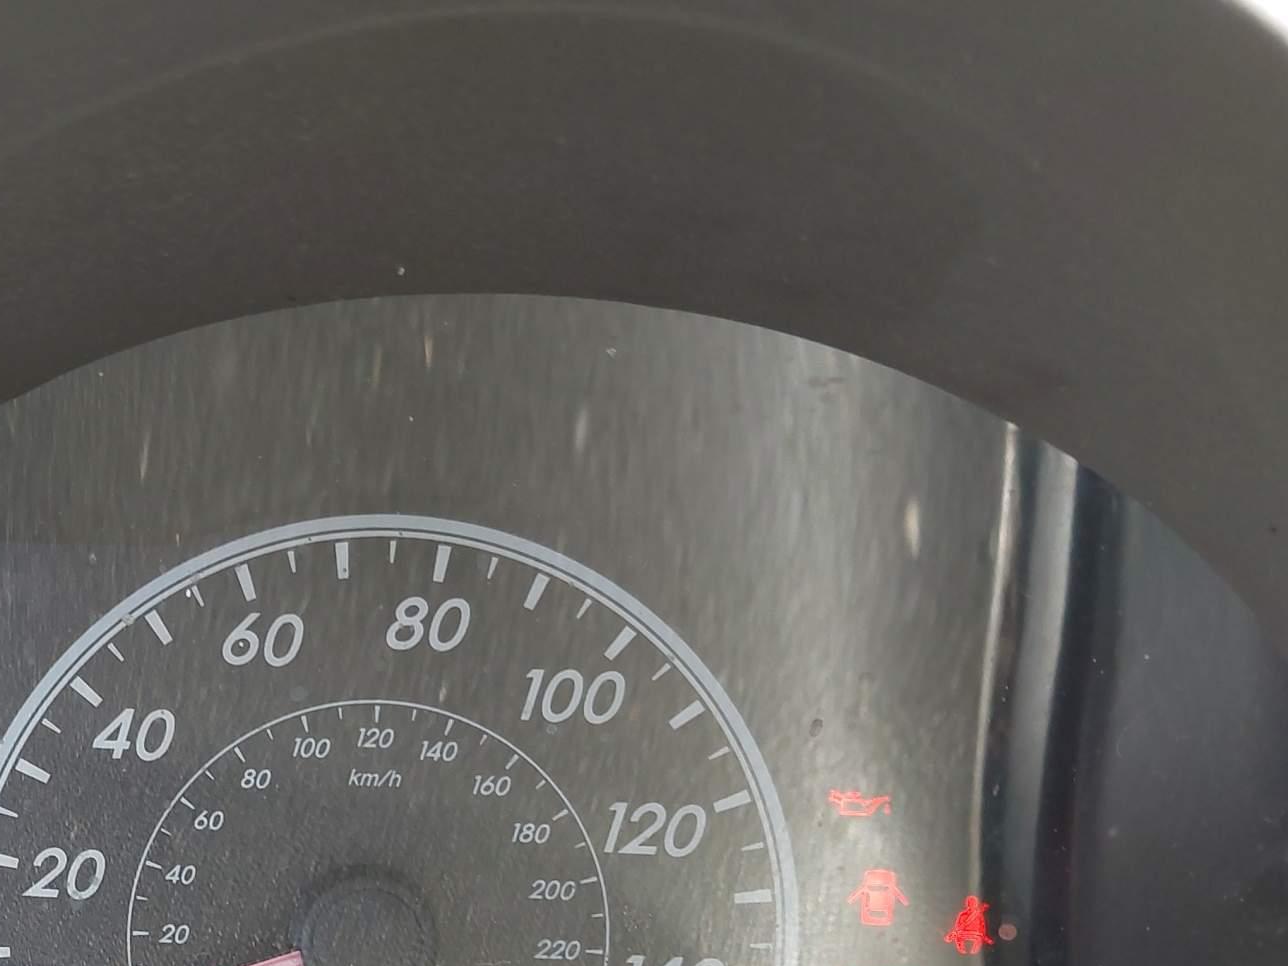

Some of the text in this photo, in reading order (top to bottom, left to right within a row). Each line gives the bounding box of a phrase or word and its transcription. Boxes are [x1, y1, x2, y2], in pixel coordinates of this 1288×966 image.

[385, 597, 470, 652] 80
[223, 613, 304, 666] 60
[522, 669, 626, 725] 100
[93, 709, 175, 761] 40
[356, 728, 394, 749] 120
[291, 737, 331, 759] 100
[419, 739, 458, 763] 140
[241, 769, 271, 790] 80
[348, 767, 402, 789] km/h
[472, 775, 511, 797] 160
[194, 811, 224, 831] 60
[603, 803, 706, 857] 120
[512, 823, 550, 844] 180
[23, 849, 105, 900] 20
[165, 864, 196, 885] 40
[529, 880, 575, 901] 200
[159, 925, 189, 944] 20
[534, 940, 580, 960] 220
